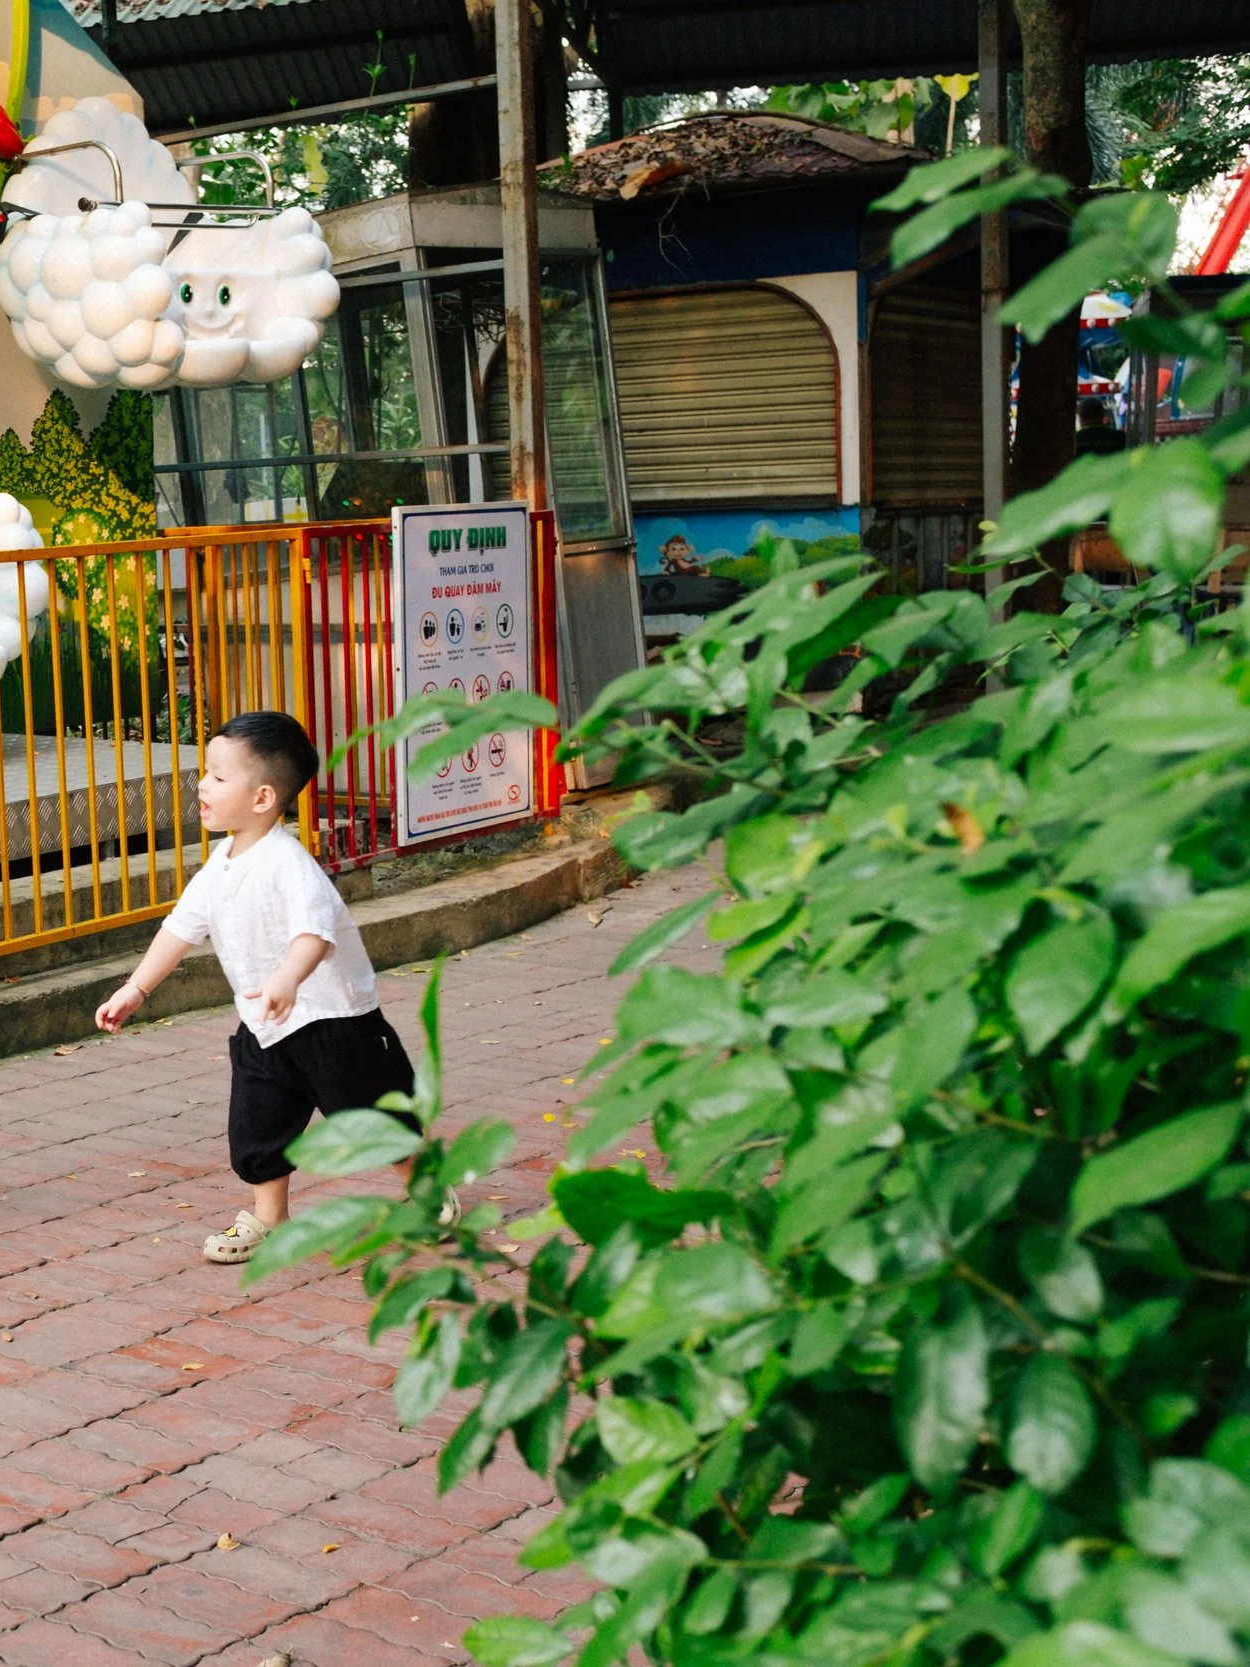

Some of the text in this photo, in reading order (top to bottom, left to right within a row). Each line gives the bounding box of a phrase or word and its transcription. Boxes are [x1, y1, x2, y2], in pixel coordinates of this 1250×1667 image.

[429, 526, 507, 557] QUY ĐỊNH
[439, 566, 456, 576] THAM
[457, 565, 468, 575] GIA
[444, 584, 465, 598] QUAY
